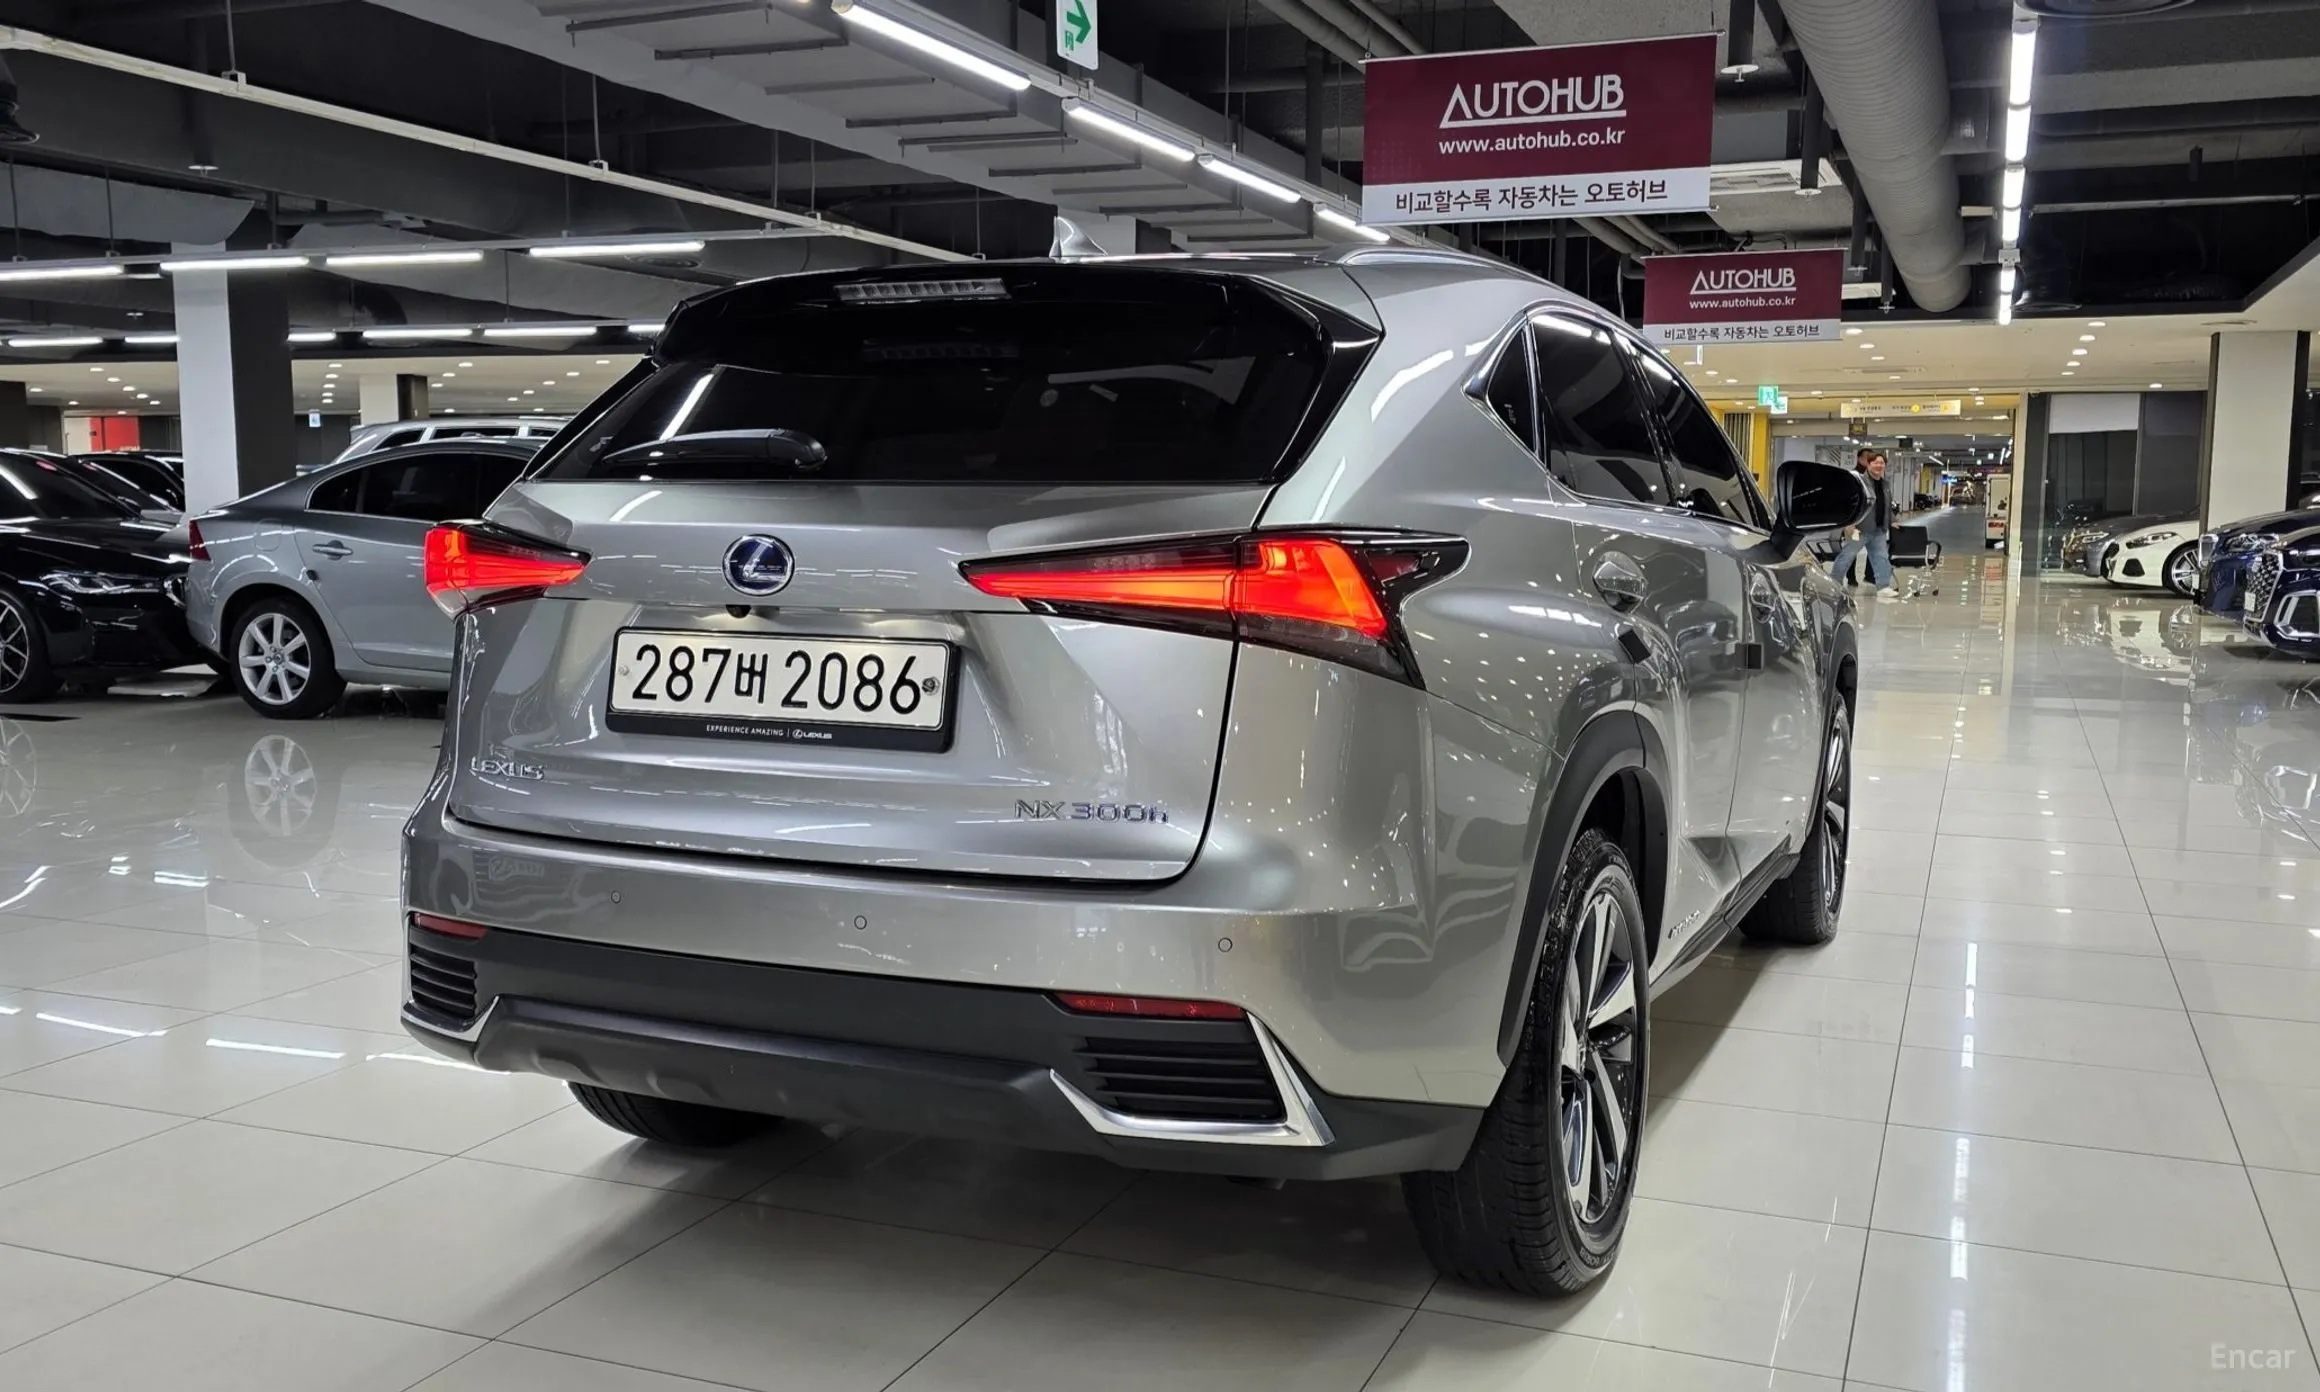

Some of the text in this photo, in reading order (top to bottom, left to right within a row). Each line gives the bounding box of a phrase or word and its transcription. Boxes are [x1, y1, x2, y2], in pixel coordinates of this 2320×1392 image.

[1440, 75, 1626, 128] AUTOHUB
[1439, 127, 1625, 153] www.autohub.co.kr
[1396, 180, 1668, 213] 비교할수록 자동차는 오토허브
[1690, 268, 1796, 294] AUTOHUB
[1689, 296, 1796, 309] www.autohub.co.kr
[1664, 323, 1820, 341] 비교할수록 자동차는 오토허브
[632, 643, 921, 714] 287버 2086
[706, 724, 749, 735] EXPERIENCE
[750, 727, 784, 737] AMAZING
[471, 756, 544, 779] LEXUS
[1014, 800, 1168, 822] NX 300h
